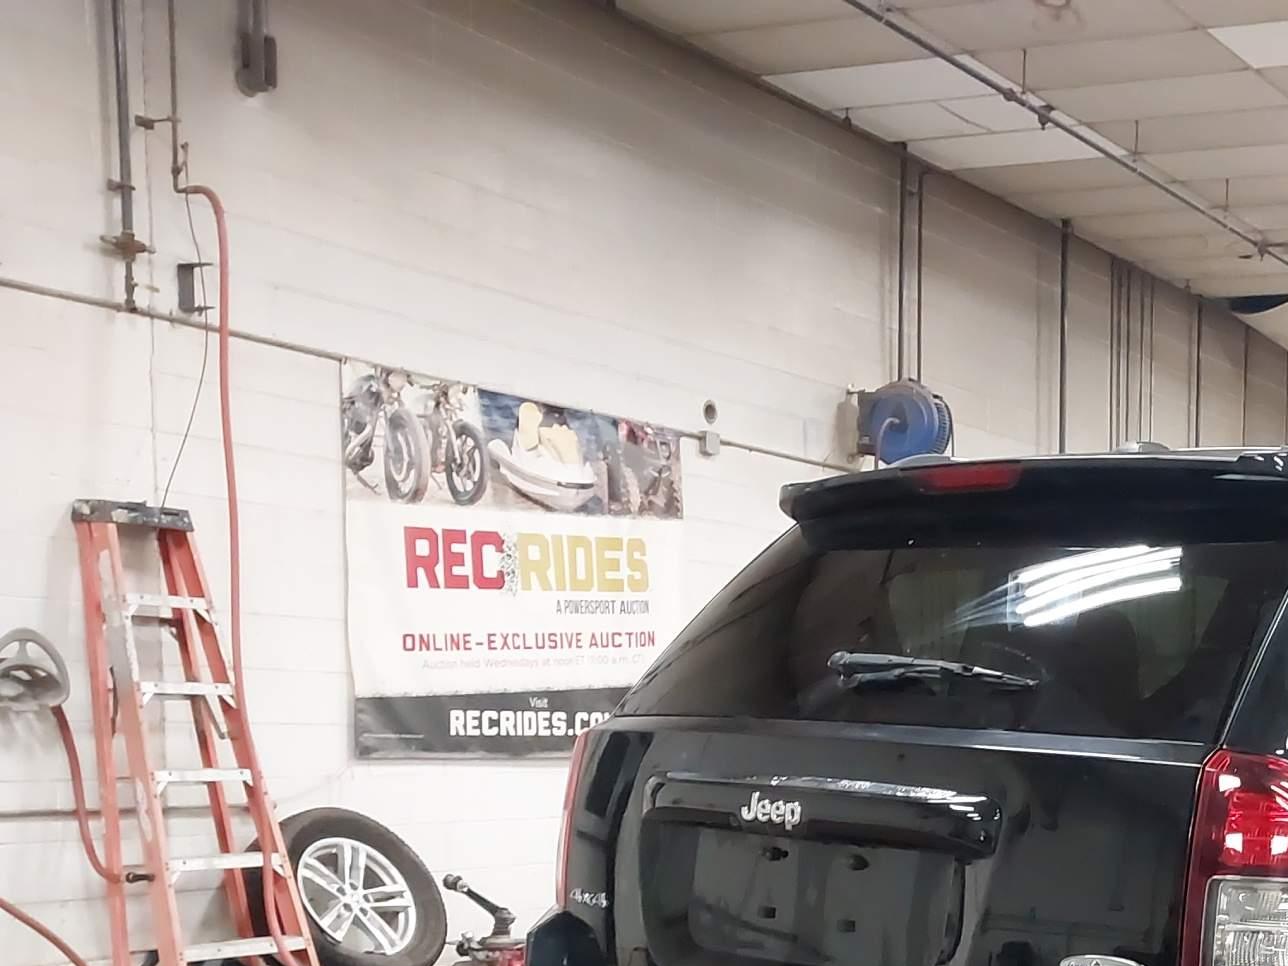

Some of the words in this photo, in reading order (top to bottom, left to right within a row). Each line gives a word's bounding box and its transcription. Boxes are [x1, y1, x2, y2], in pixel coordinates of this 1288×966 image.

[403, 526, 506, 590] REC
[516, 532, 650, 593] RIDES
[556, 600, 562, 615] A
[564, 600, 616, 615] POWERSPORT
[619, 600, 650, 615] AUCTION
[402, 632, 583, 652] ONLINE-EXCLUSIVE
[589, 631, 656, 649] AUCTION
[529, 697, 549, 709] Visit
[449, 709, 611, 737] RECRIDES.CO
[741, 791, 801, 831] Jeep
[569, 888, 608, 908] 4x4
